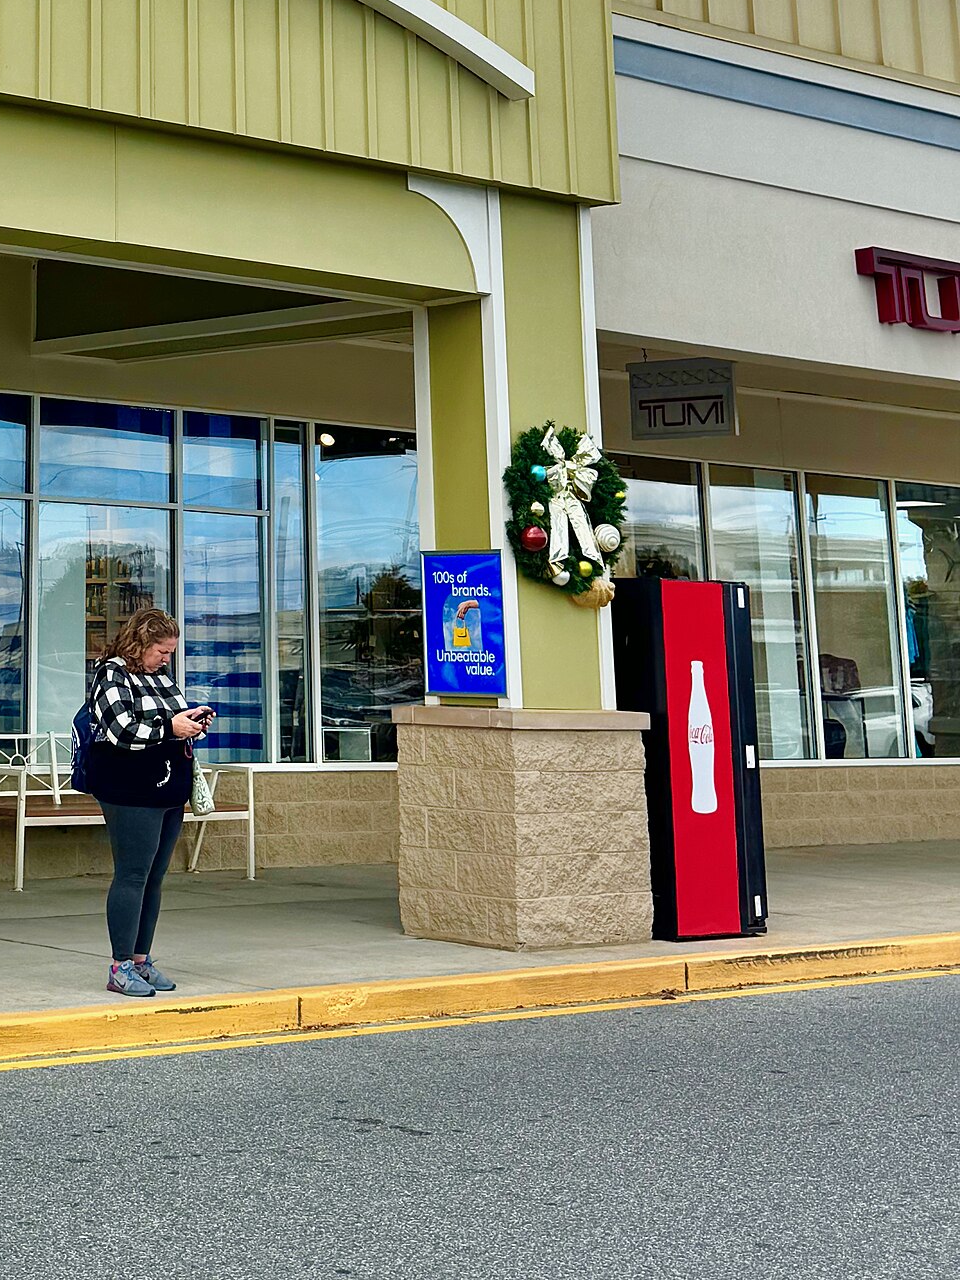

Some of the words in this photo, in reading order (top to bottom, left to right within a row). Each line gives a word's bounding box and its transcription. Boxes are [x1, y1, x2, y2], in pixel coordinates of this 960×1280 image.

[854, 246, 960, 333] TU
[639, 395, 725, 428] TUMI
[432, 571, 454, 584] 100s
[456, 571, 467, 583] of
[451, 584, 491, 596] brands.
[436, 649, 495, 663] Unbeatable
[465, 663, 495, 676] value.
